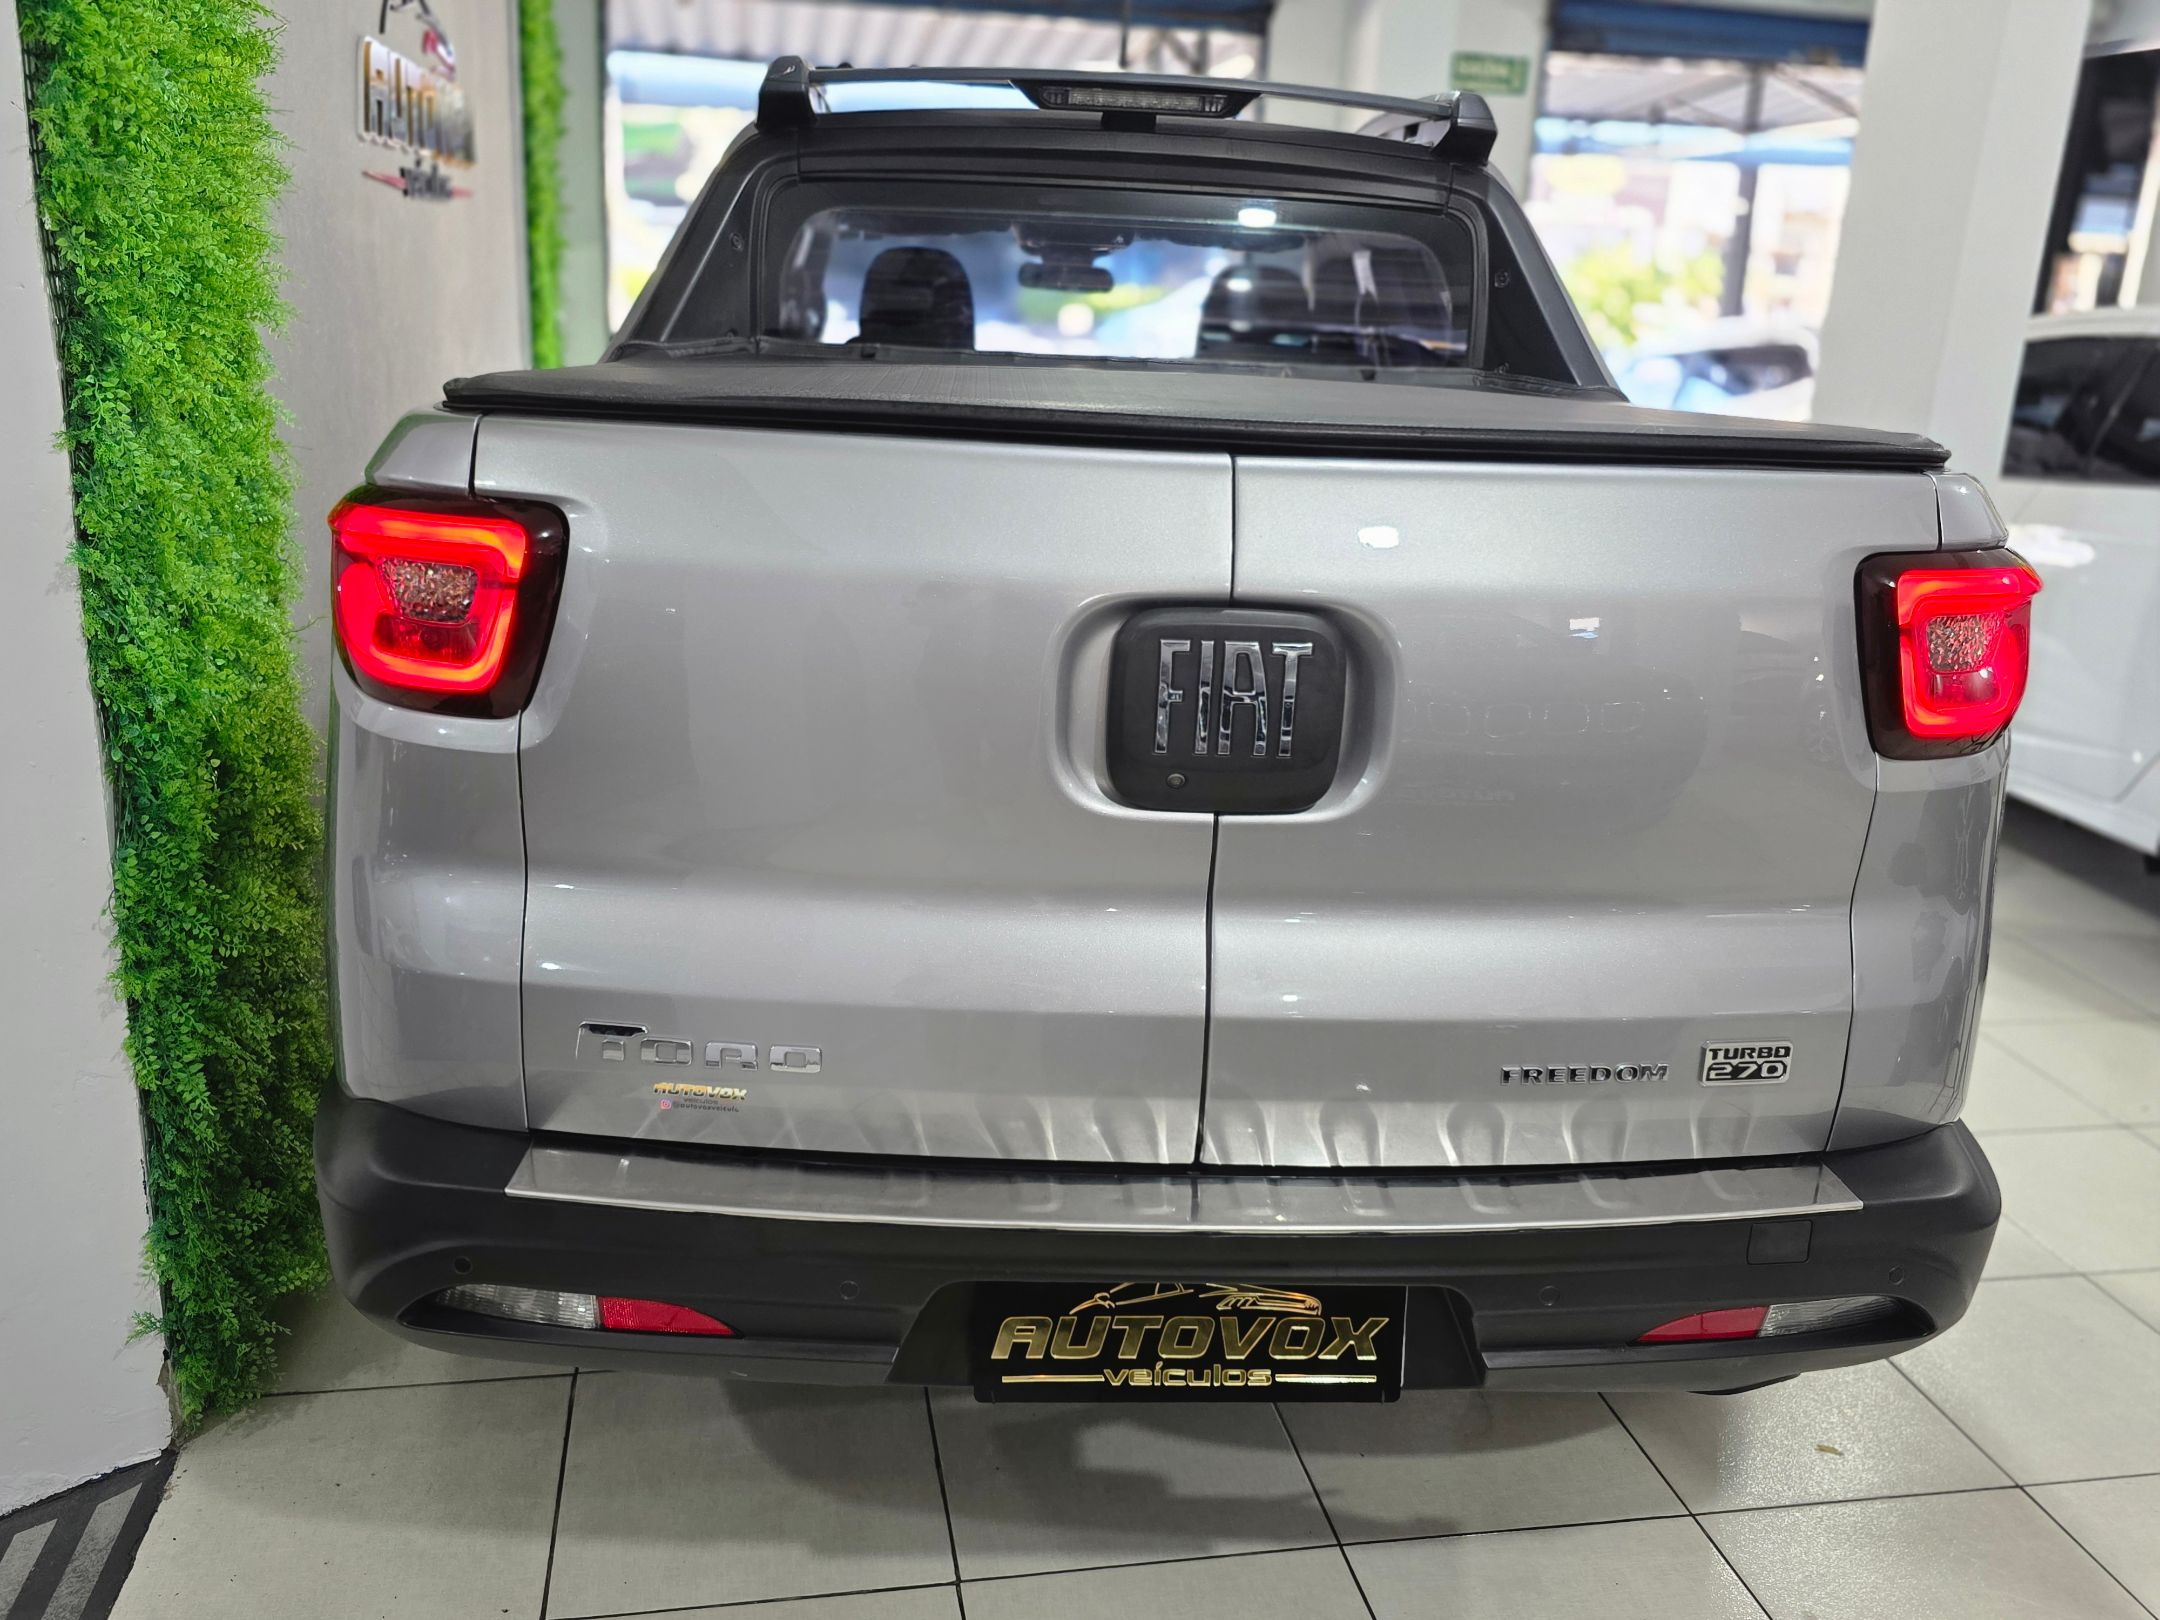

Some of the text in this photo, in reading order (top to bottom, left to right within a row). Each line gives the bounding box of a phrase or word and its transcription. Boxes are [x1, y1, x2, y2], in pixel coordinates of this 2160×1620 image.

[1154, 639, 1313, 757] FIAT
[576, 1020, 823, 1073] TORO
[1708, 1046, 1791, 1061] TURBO
[1501, 1063, 1669, 1085] FREEDOM
[1708, 1062, 1786, 1080] 270
[654, 1082, 747, 1100] AUTOVOX
[991, 1315, 1389, 1360] AUTOVOX
[1103, 1362, 1272, 1386] veículos
